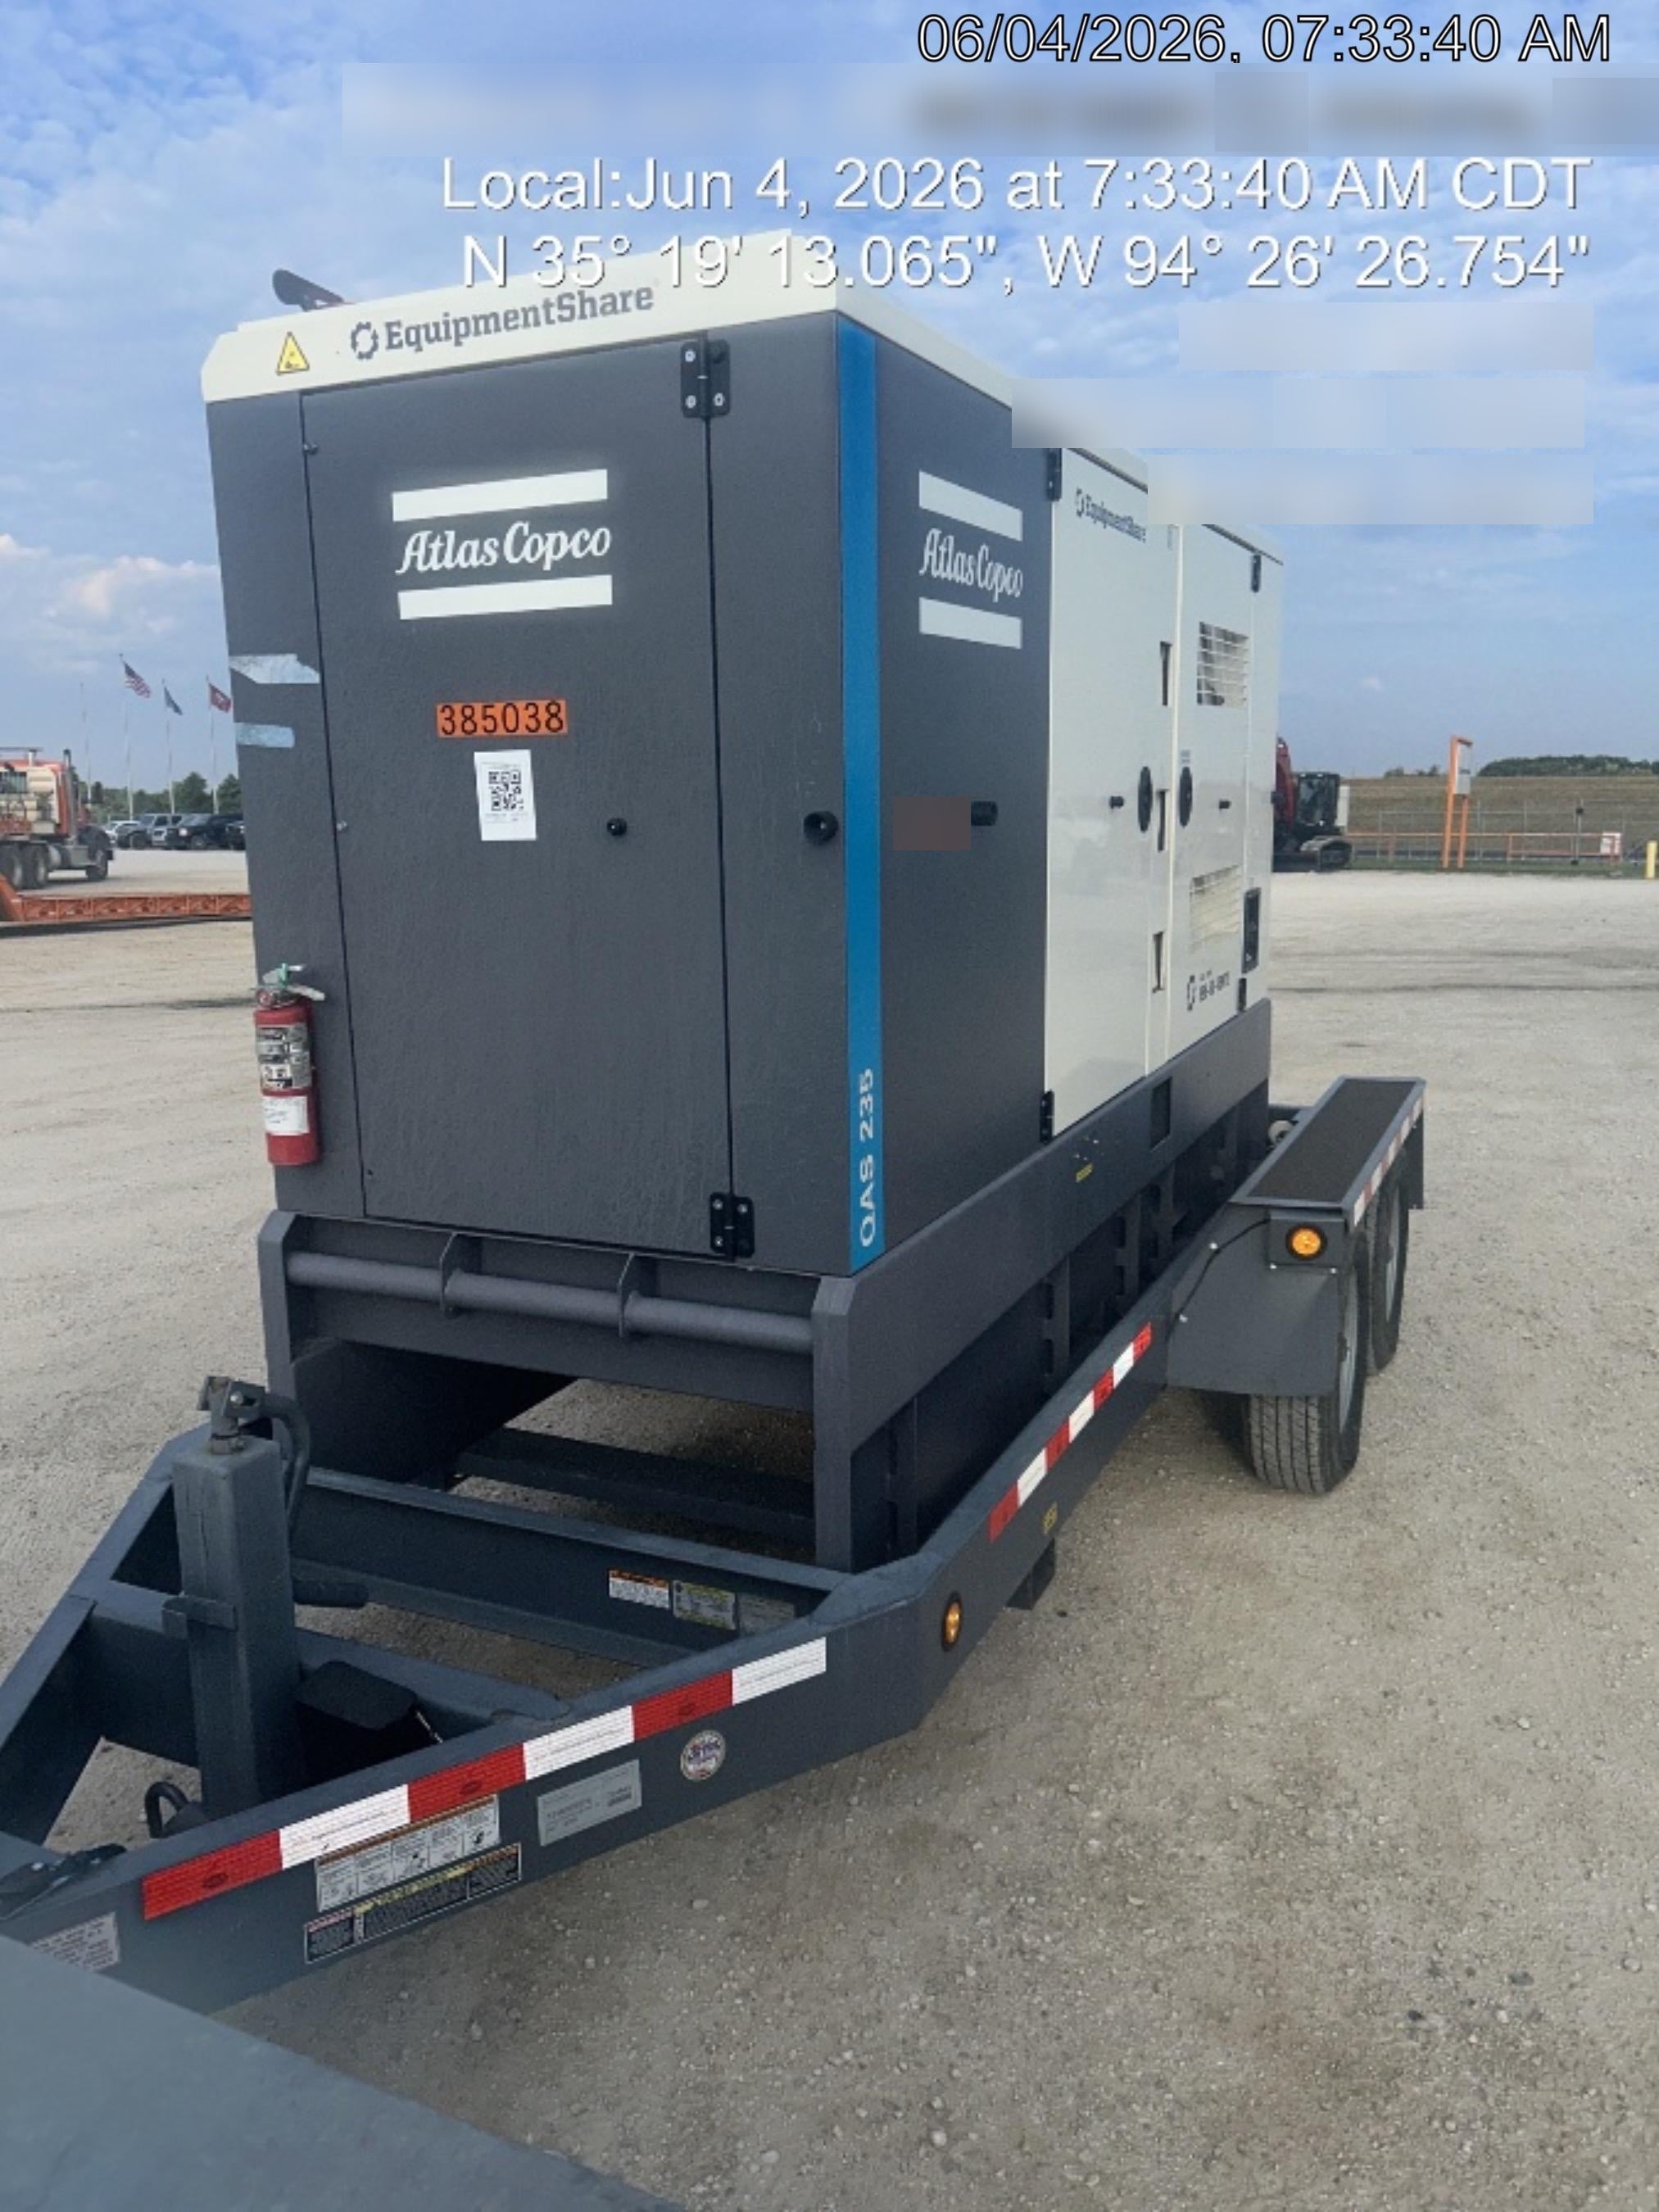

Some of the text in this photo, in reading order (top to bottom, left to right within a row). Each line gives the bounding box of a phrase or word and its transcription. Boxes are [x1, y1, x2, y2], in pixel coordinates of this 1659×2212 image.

[384, 284, 655, 352] EquipmentShare
[395, 520, 611, 575] Atlas Copco
[919, 528, 1023, 602] Atlas Copco
[439, 700, 564, 735] 385038
[859, 1068, 876, 1248] QAS 235
